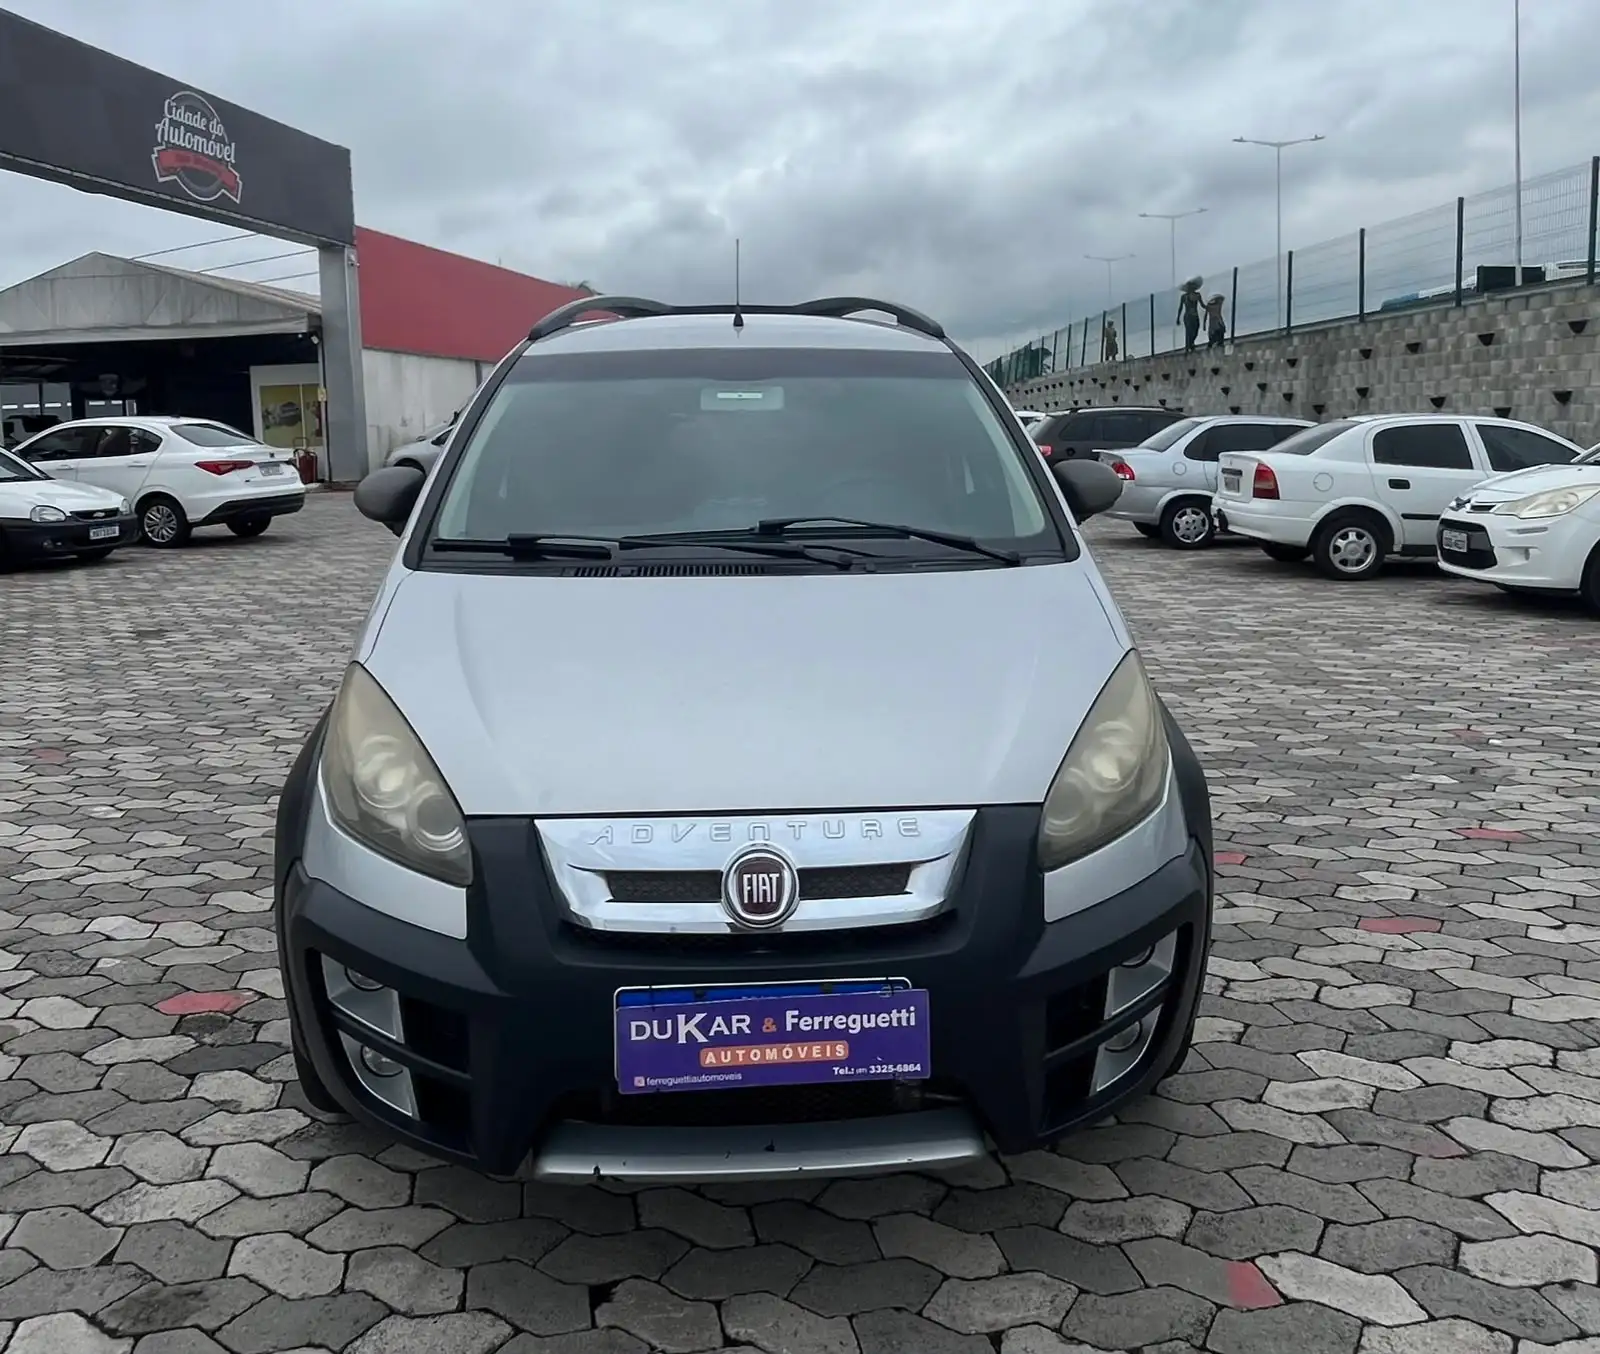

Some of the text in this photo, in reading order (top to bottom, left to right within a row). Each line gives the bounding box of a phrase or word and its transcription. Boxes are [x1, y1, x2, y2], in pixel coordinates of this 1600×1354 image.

[164, 99, 224, 136] Cidade do
[155, 117, 236, 163] Automóvel
[588, 818, 921, 845] ADVENTURE
[743, 872, 780, 904] FIAT
[762, 1017, 777, 1033] &
[785, 1006, 917, 1034] Ferreguetti
[704, 1043, 847, 1066] AUTOMÓVEIS
